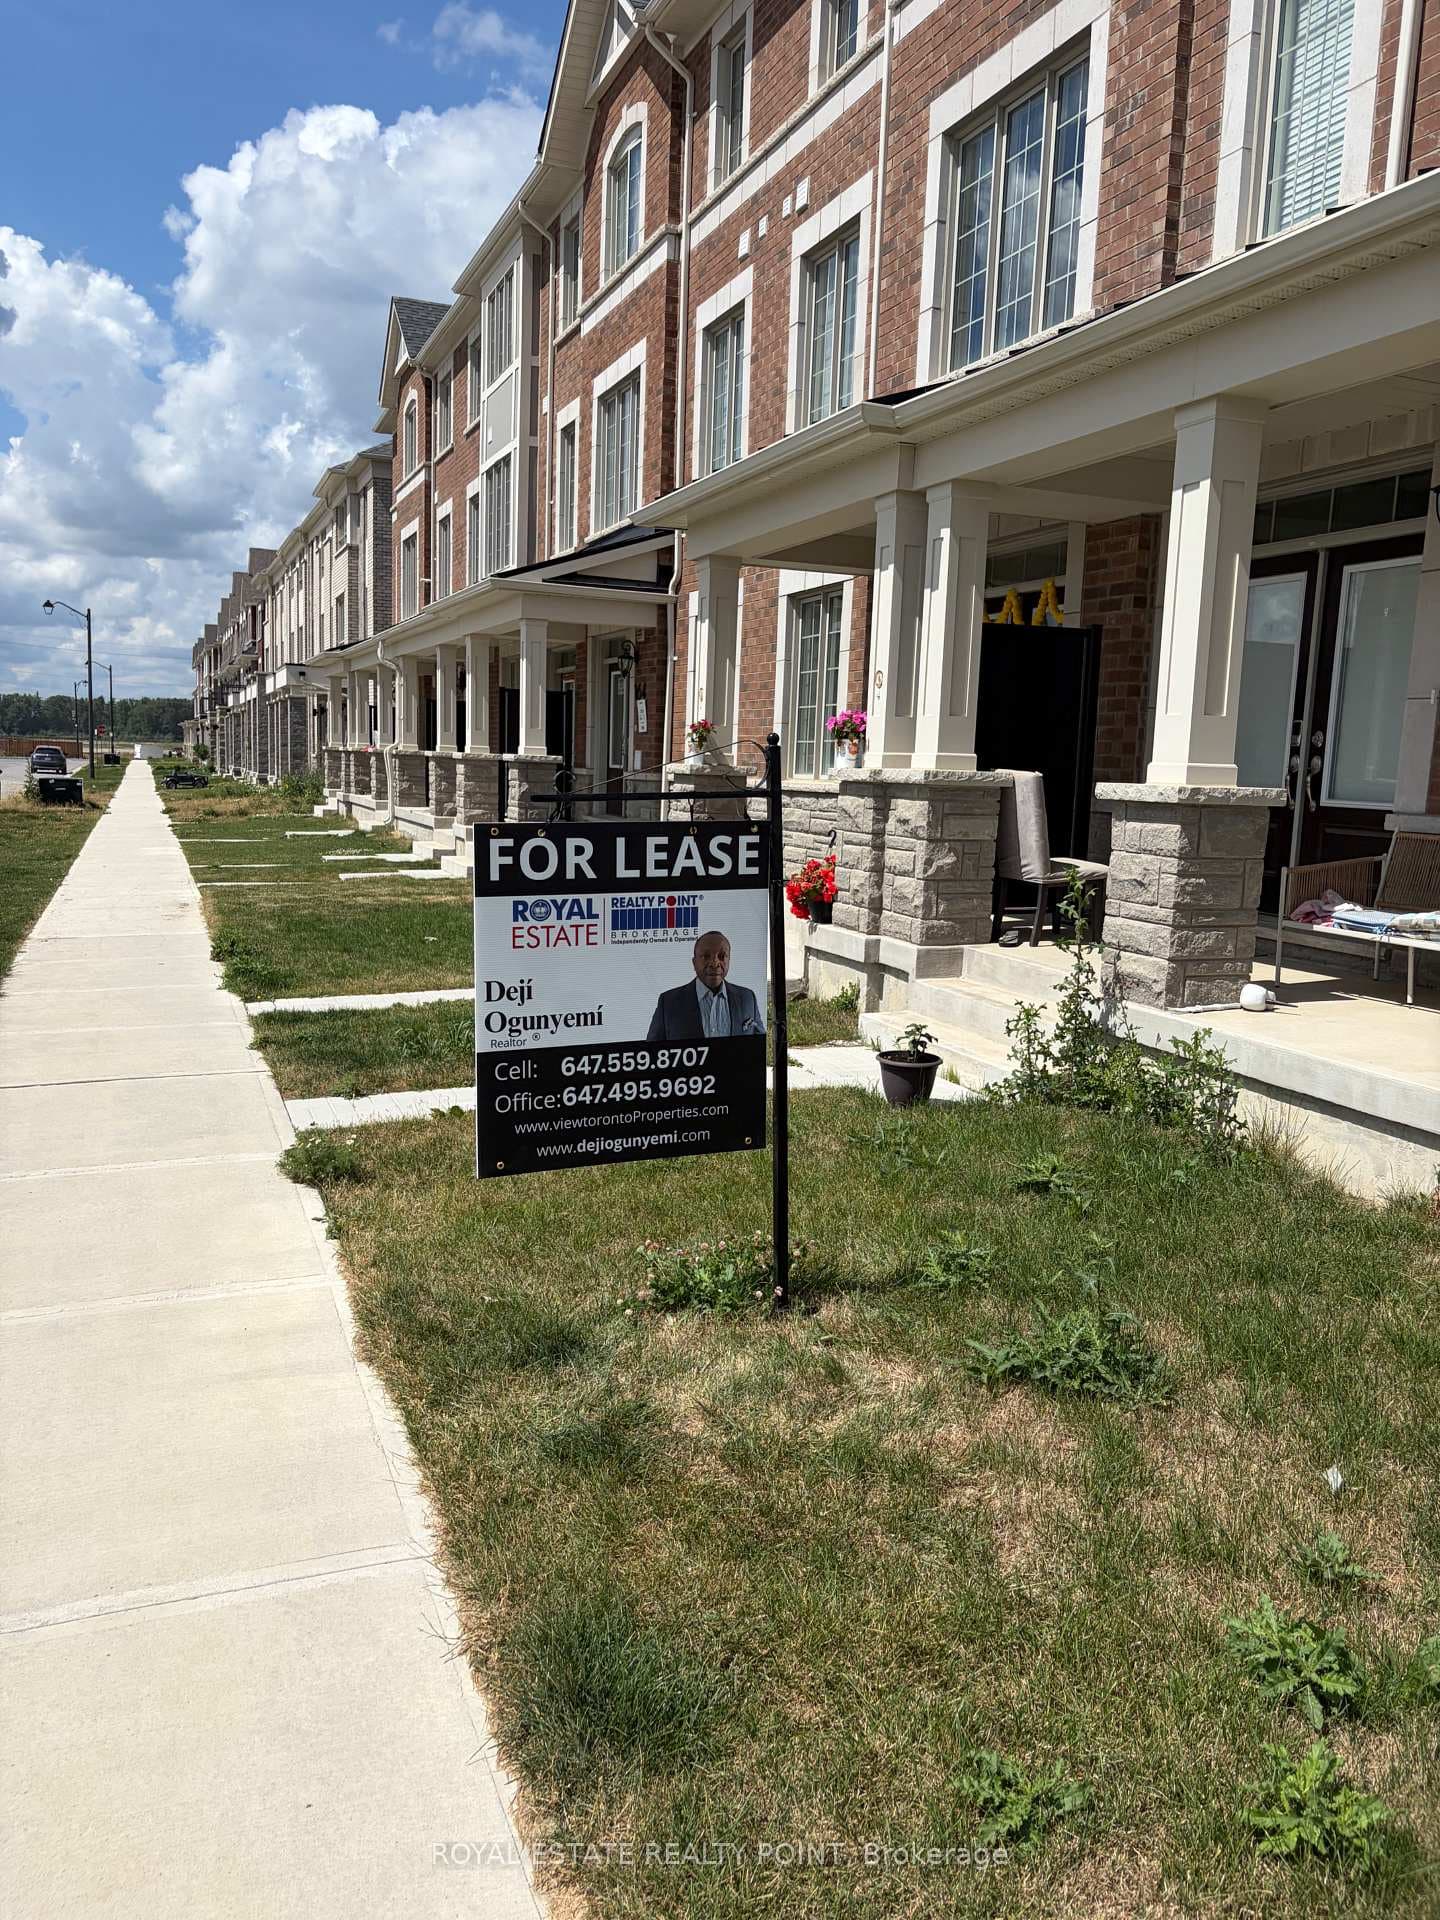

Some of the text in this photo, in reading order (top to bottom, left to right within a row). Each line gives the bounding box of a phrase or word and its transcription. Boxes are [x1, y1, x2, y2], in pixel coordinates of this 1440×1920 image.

[489, 835, 760, 882] FOR LEASE
[512, 896, 600, 923] ROYAL
[611, 896, 655, 908] REALTY
[512, 924, 598, 949] ESTATE
[611, 928, 698, 939] BROKERAGE
[611, 938, 648, 946] Independently
[490, 1038, 527, 1049] Realtor
[494, 1046, 710, 1081] Cell: 647.559.8707
[494, 1075, 716, 1114] Office: 647.495.9692
[514, 1103, 730, 1135] www.viewtorontoProperties.com
[536, 1128, 711, 1158] www.dejiogunyemi.com
